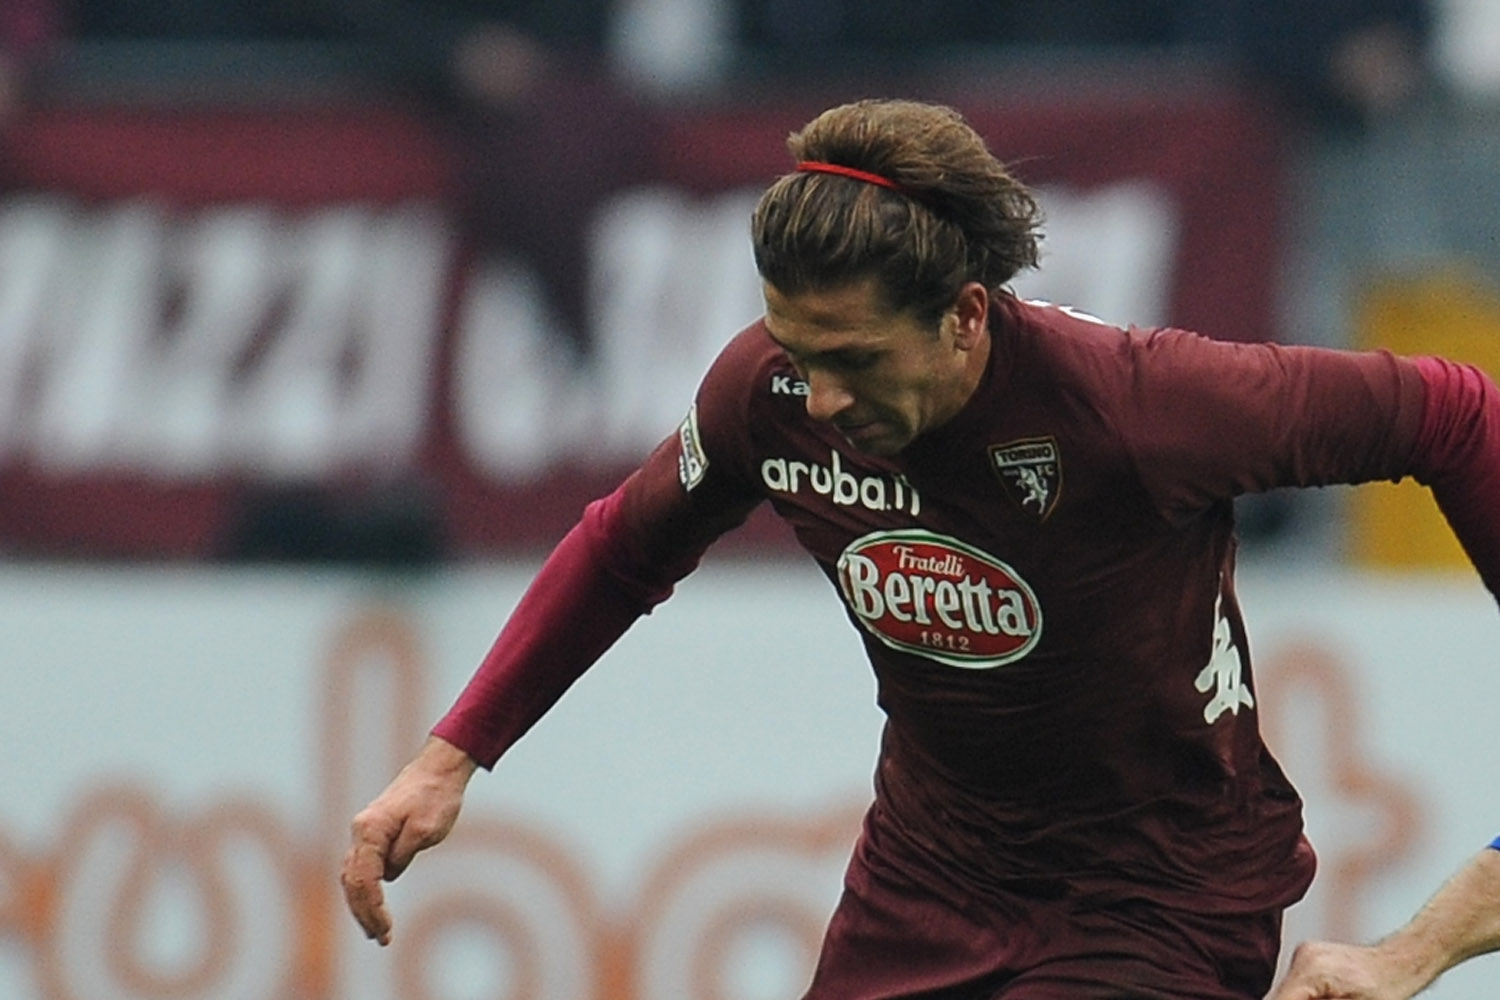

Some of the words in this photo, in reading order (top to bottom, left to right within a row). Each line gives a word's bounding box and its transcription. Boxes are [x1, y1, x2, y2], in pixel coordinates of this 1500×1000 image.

[892, 545, 966, 578] Fratelli
[847, 553, 1032, 636] Beretta
[920, 631, 971, 652] 1812
